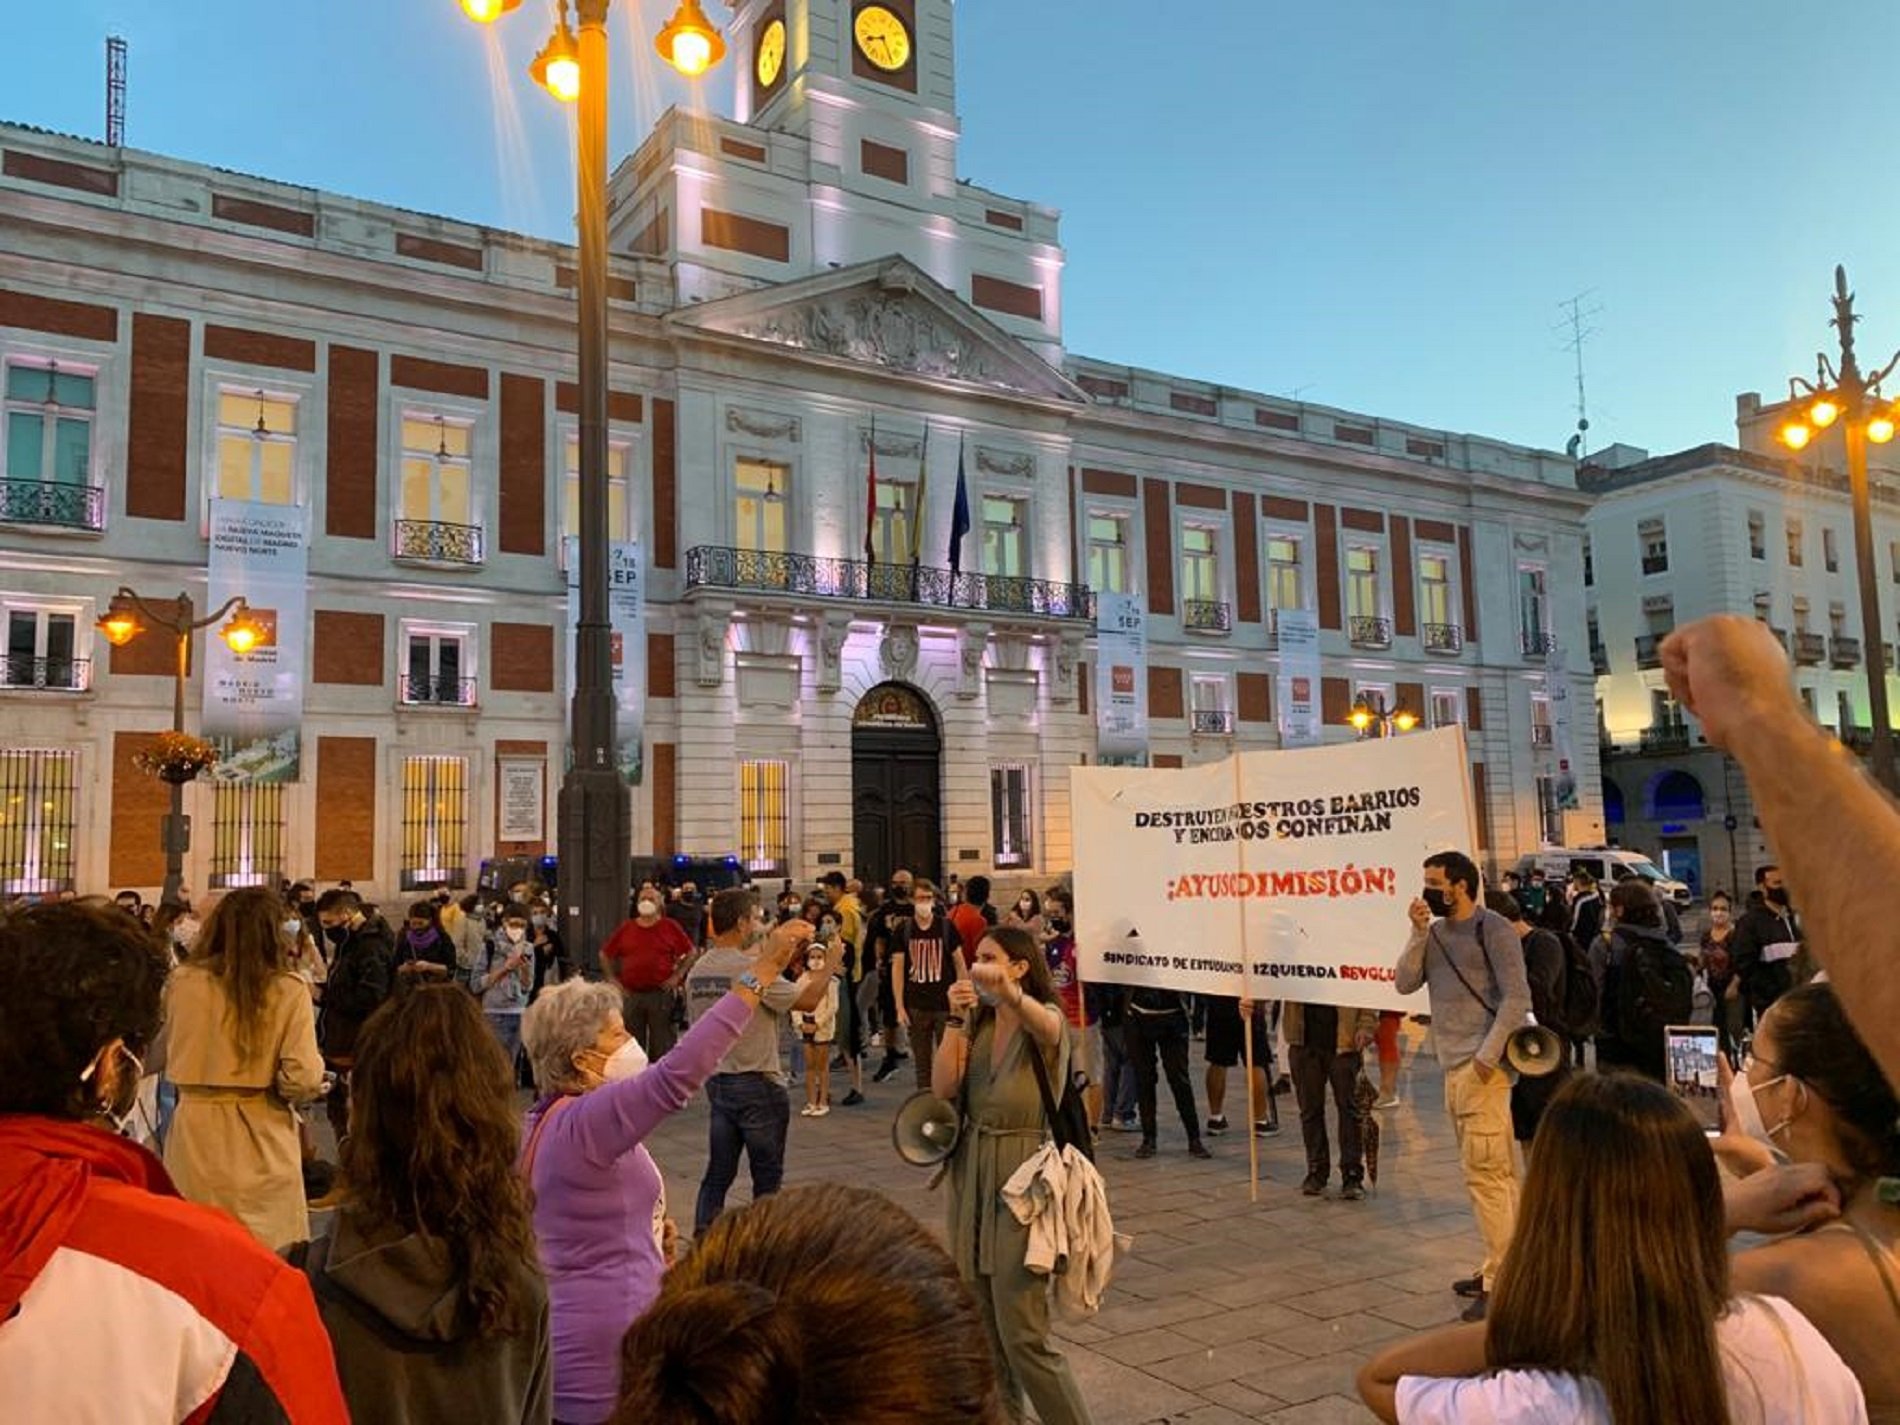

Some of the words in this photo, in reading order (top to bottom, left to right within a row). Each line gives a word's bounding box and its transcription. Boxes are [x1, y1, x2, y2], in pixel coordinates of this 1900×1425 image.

[609, 570, 637, 585] EP
[1118, 615, 1141, 628] SEP
[1229, 797, 1325, 821] ESTROS
[1330, 786, 1421, 815] BARRIOS
[1173, 828, 1187, 843] Y
[1237, 820, 1270, 840] OS
[1276, 811, 1392, 839] CONFINAN
[1102, 951, 1170, 968] SINDICATO
[1172, 956, 1188, 970] DE
[1253, 962, 1337, 978] IZQUIERDA
[1339, 963, 1397, 982] REVOLU
